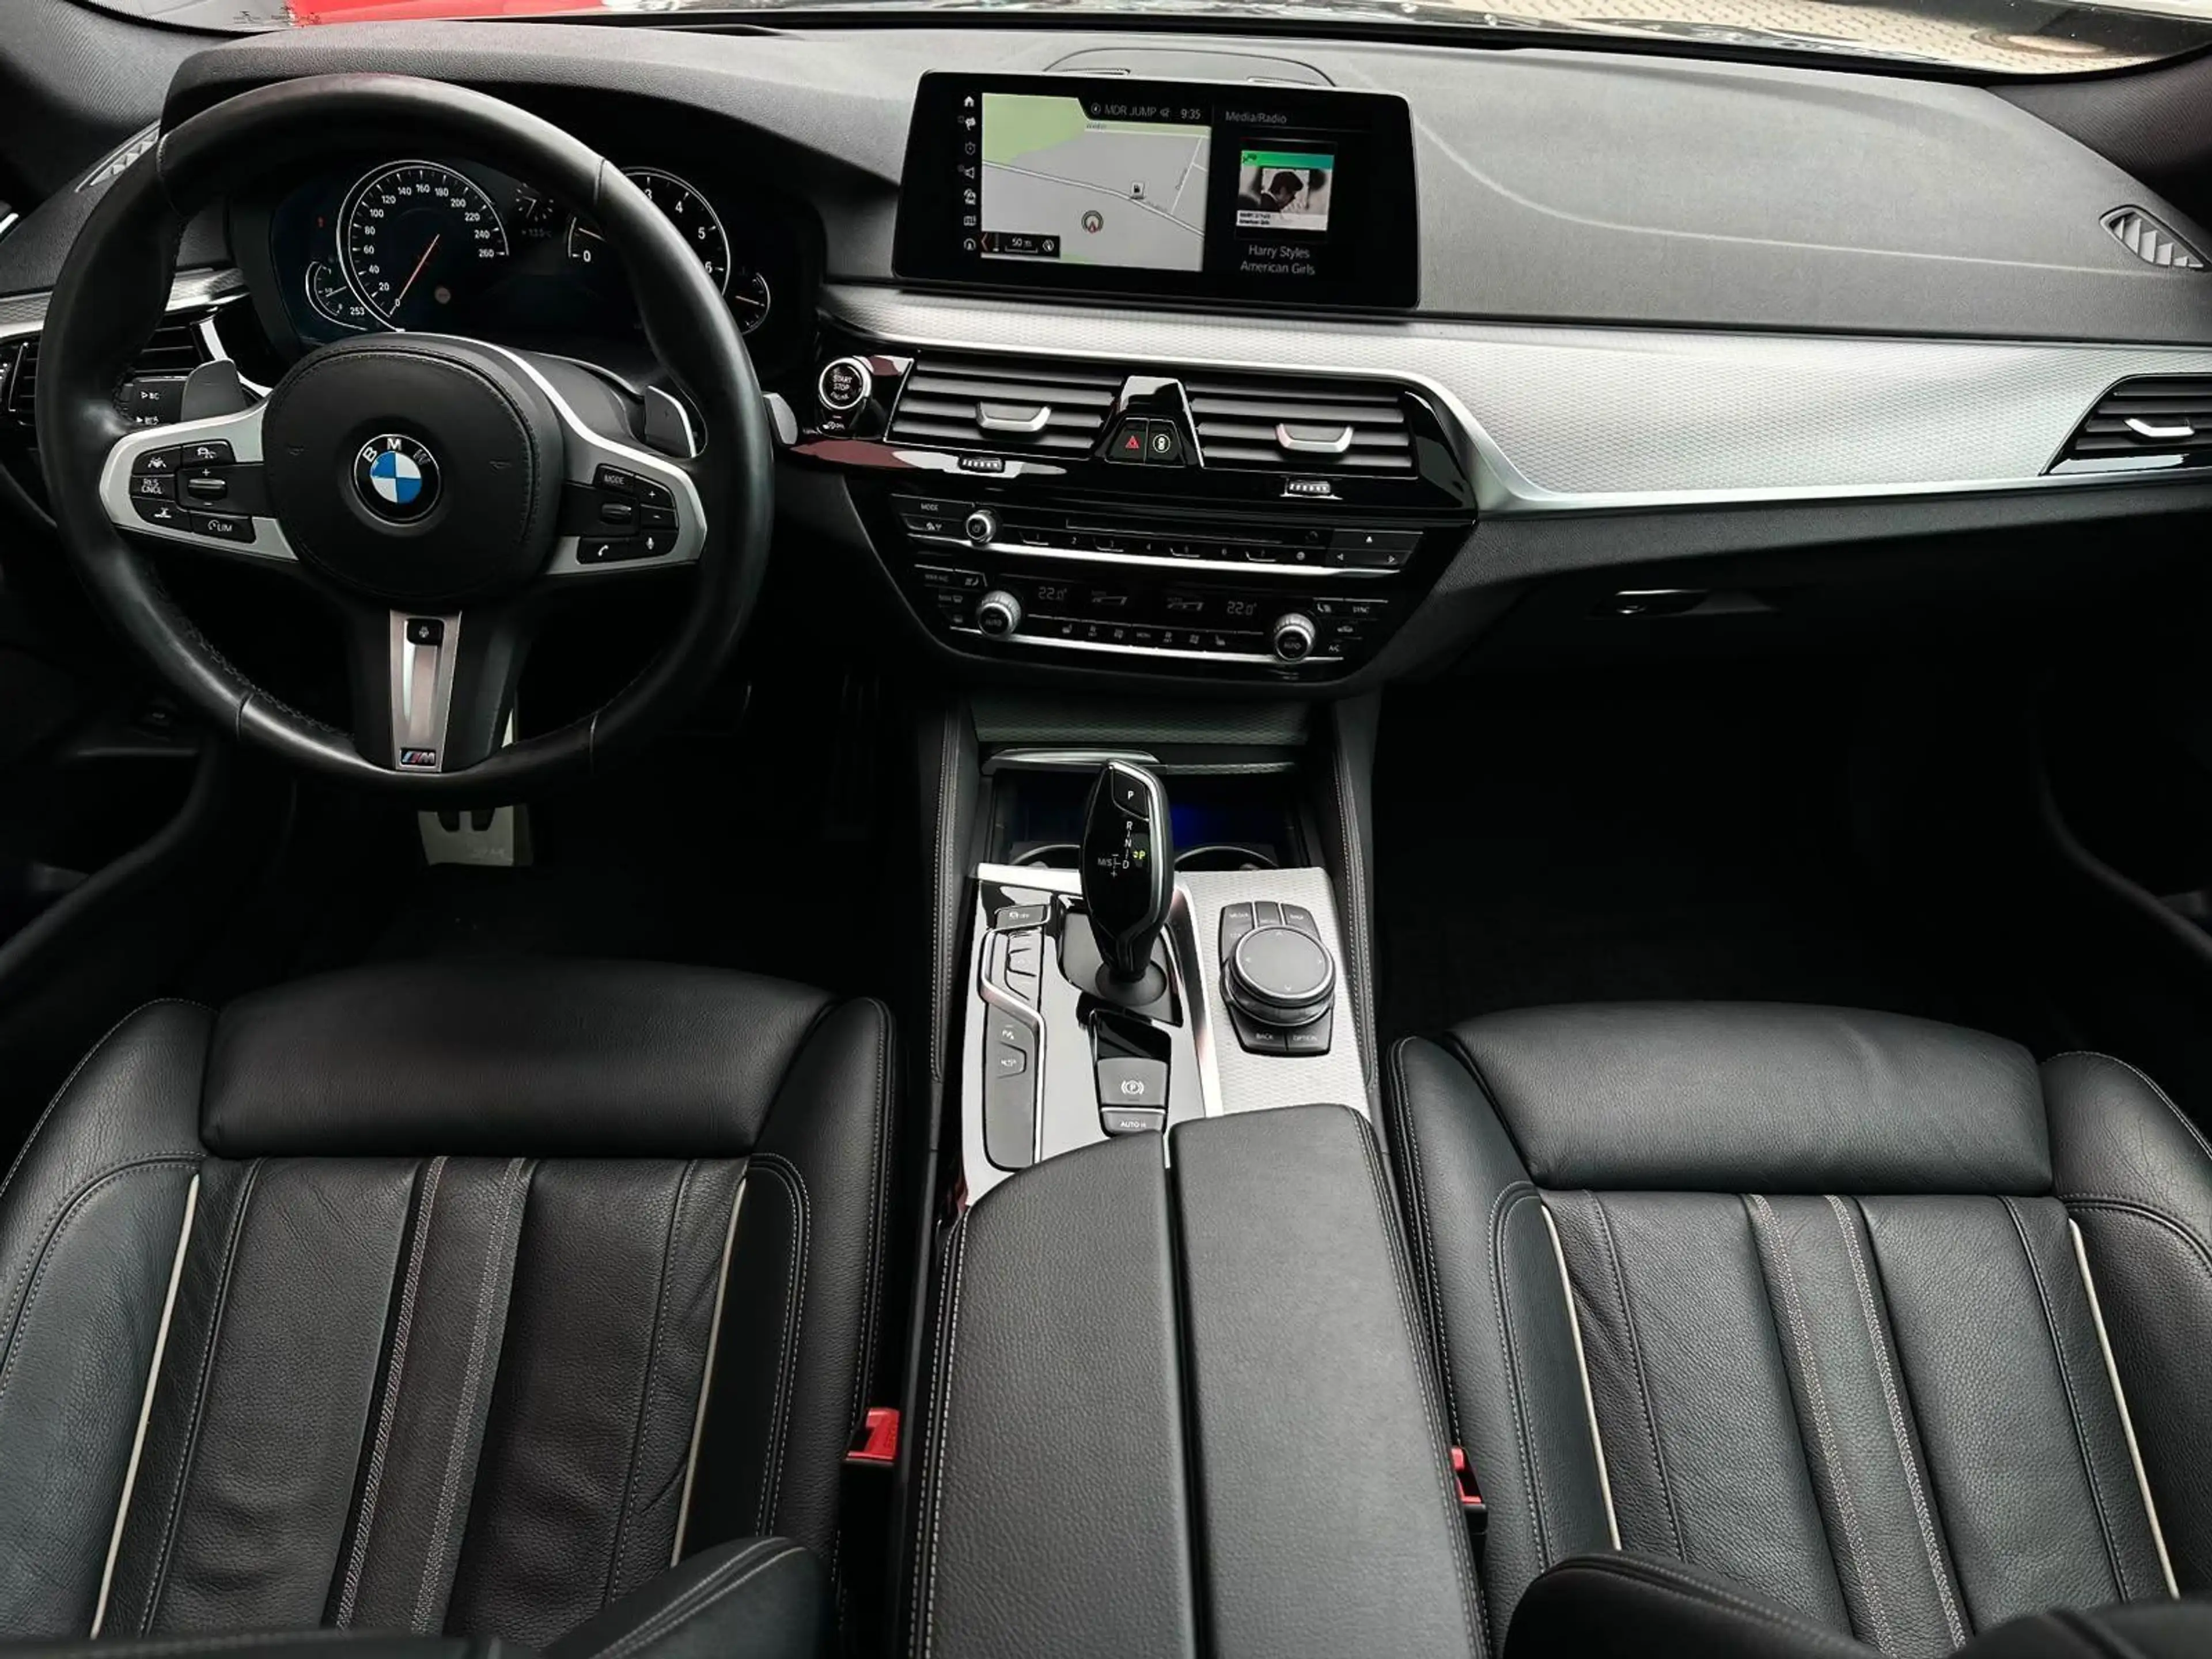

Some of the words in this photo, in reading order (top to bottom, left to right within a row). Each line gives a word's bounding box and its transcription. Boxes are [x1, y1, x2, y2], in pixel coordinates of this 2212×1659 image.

[1130, 105, 1157, 116] JUMP
[1180, 108, 1202, 119] 9:35
[1225, 111, 1288, 124] Media/Radio
[397, 187, 411, 196] 140
[416, 183, 431, 193] 160
[435, 187, 449, 197] 180
[382, 195, 396, 204] 120
[450, 198, 467, 208] 200
[675, 200, 683, 213] 4
[370, 208, 384, 218] 100
[464, 212, 480, 221] 220
[365, 226, 376, 235] 80
[474, 230, 490, 240] 240
[698, 227, 706, 239] 5
[363, 245, 374, 254] 60
[479, 249, 494, 258] 260
[1248, 245, 1277, 258] Harry
[1279, 246, 1310, 260] Styles
[583, 250, 592, 263] 0
[369, 264, 380, 274] 40
[704, 262, 713, 274] 6
[1240, 260, 1289, 274] American
[1291, 263, 1316, 275] Girls
[378, 282, 390, 291] 20
[395, 298, 401, 307] 0
[350, 306, 365, 316] 253
[832, 374, 853, 384] START
[834, 382, 850, 391] STOP
[362, 438, 431, 466] BMW
[604, 474, 625, 485] MODE
[1071, 536, 1077, 544] 2
[1128, 790, 1134, 800] P
[1126, 821, 1132, 830] R
[1125, 838, 1131, 847] N
[1123, 860, 1129, 869] D
[1256, 1032, 1273, 1040] BACK
